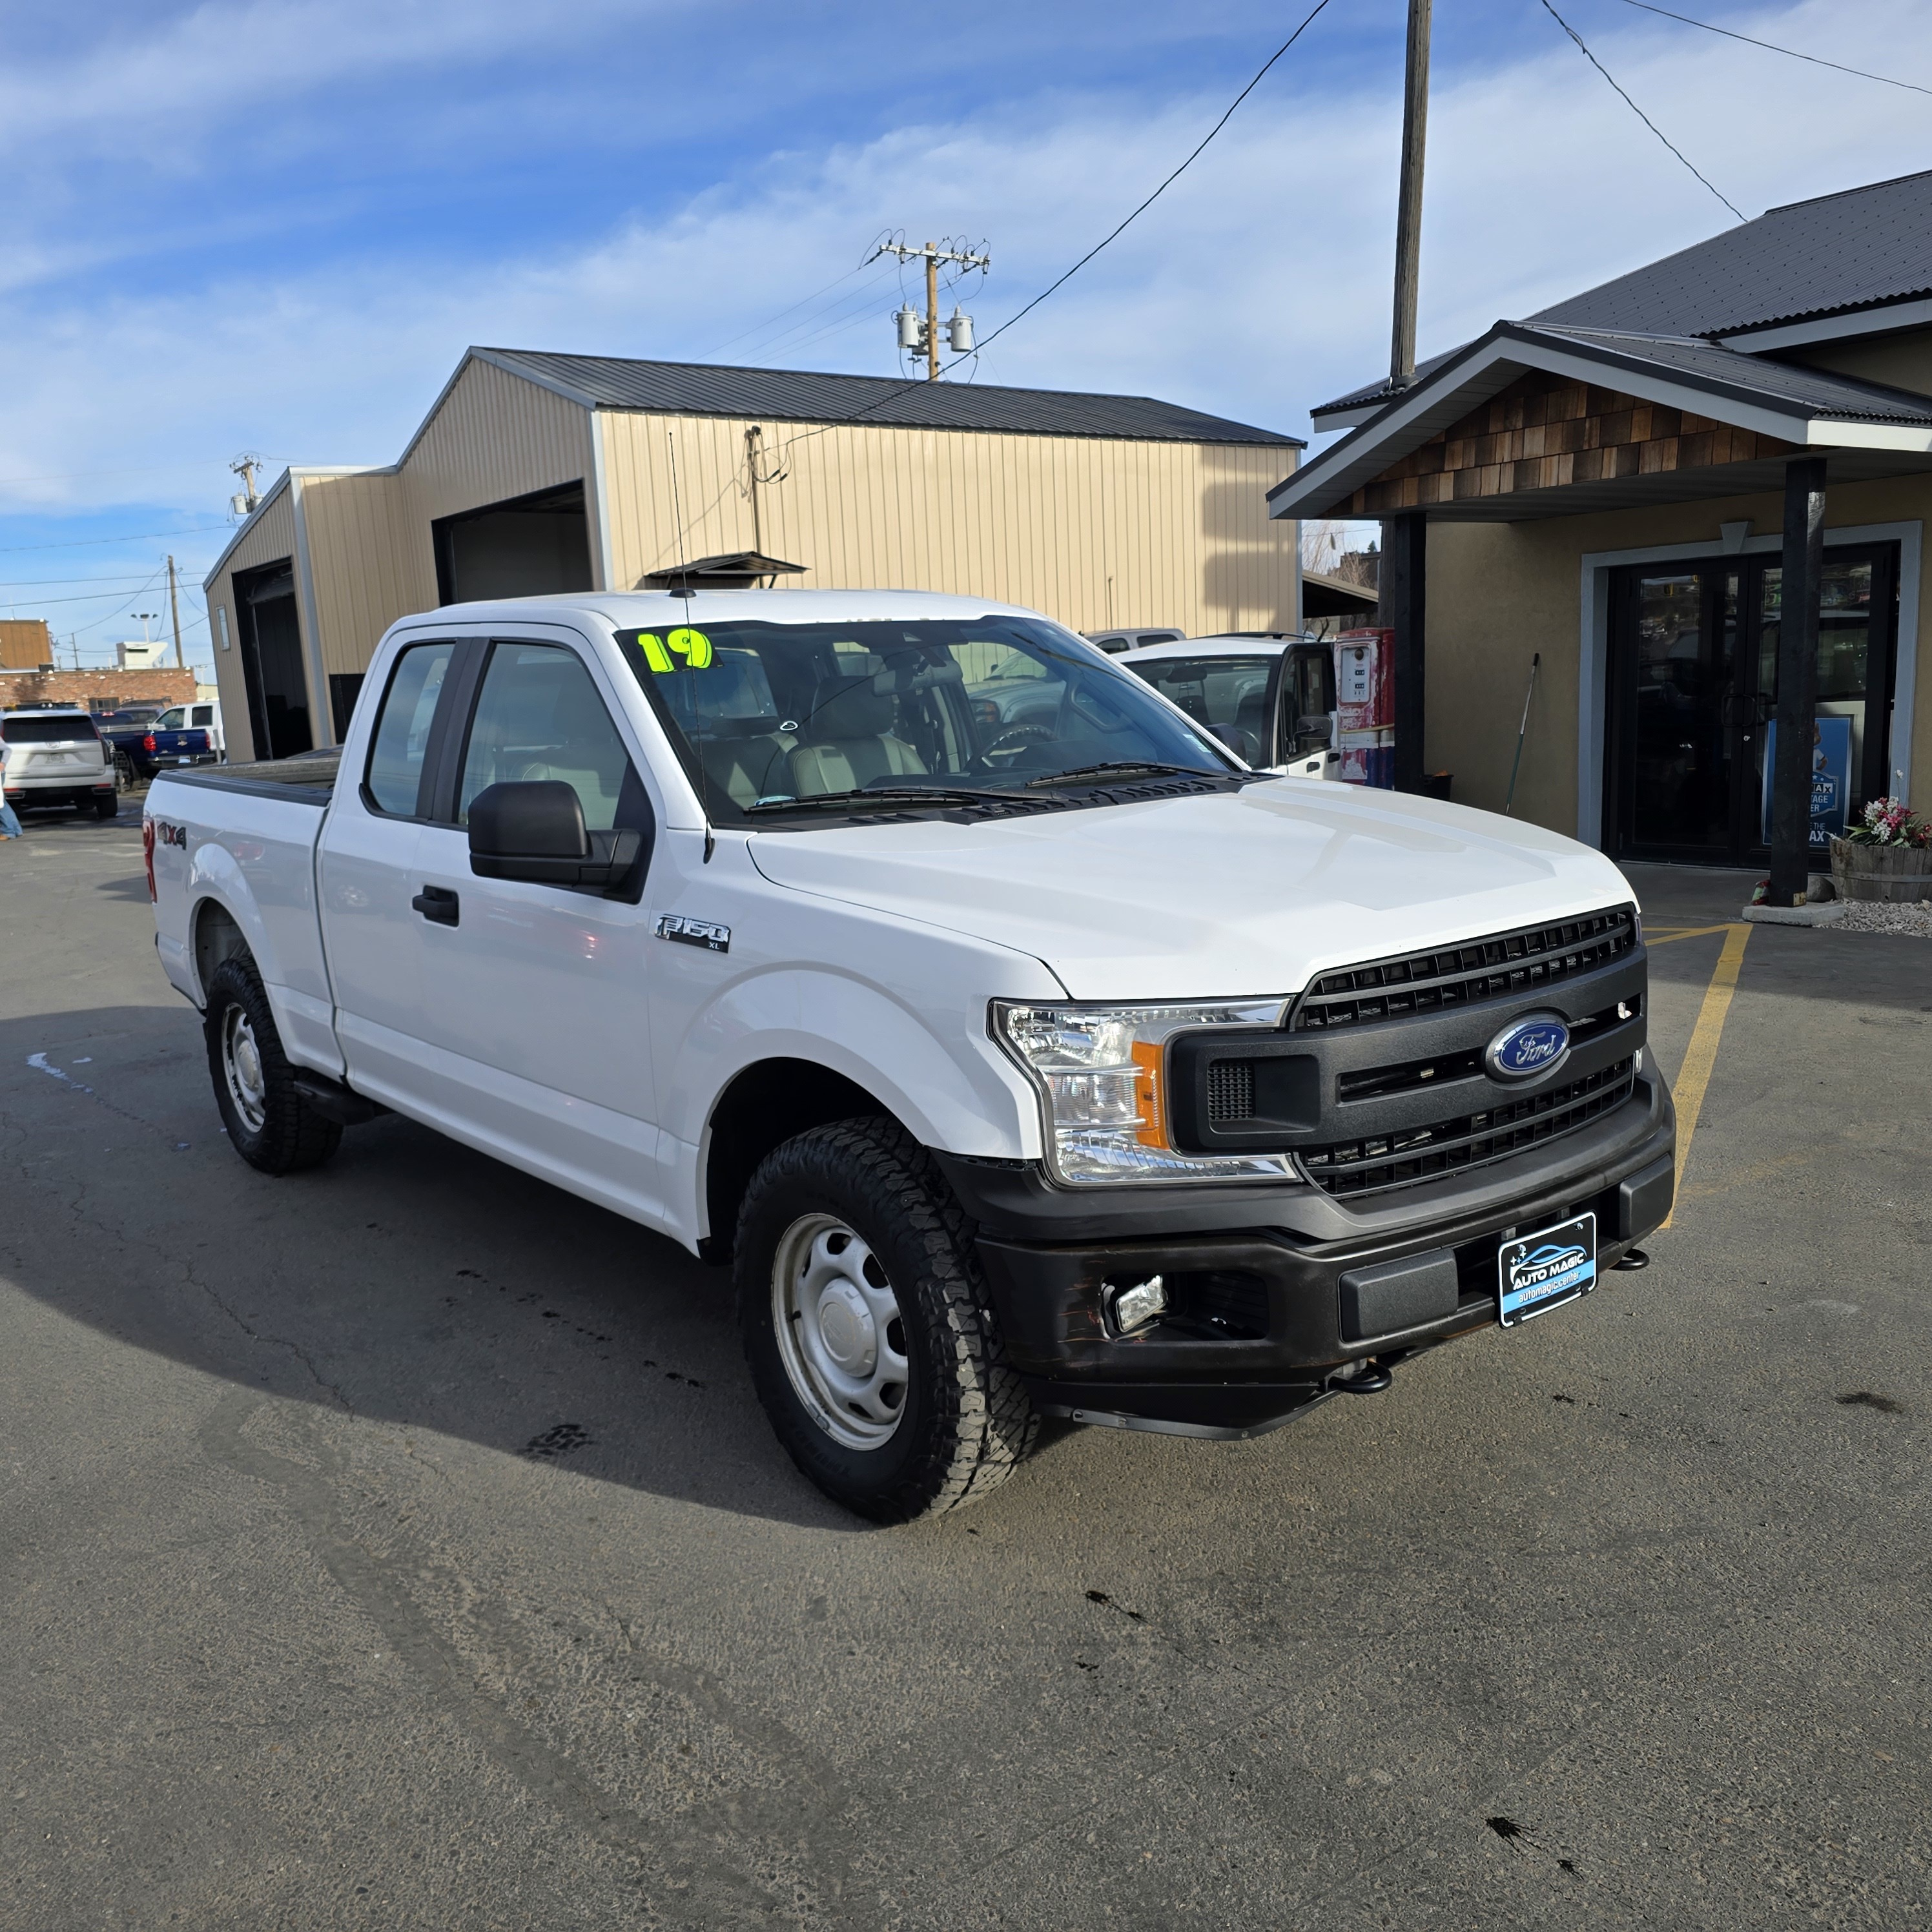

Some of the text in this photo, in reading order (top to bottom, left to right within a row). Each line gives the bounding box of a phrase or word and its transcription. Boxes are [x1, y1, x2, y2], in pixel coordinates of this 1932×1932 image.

[637, 628, 712, 672] 19
[1516, 1032, 1557, 1065] Ford
[1513, 1252, 1585, 1290] AUTO MAGIC
[1519, 1270, 1581, 1303] automagic.center
